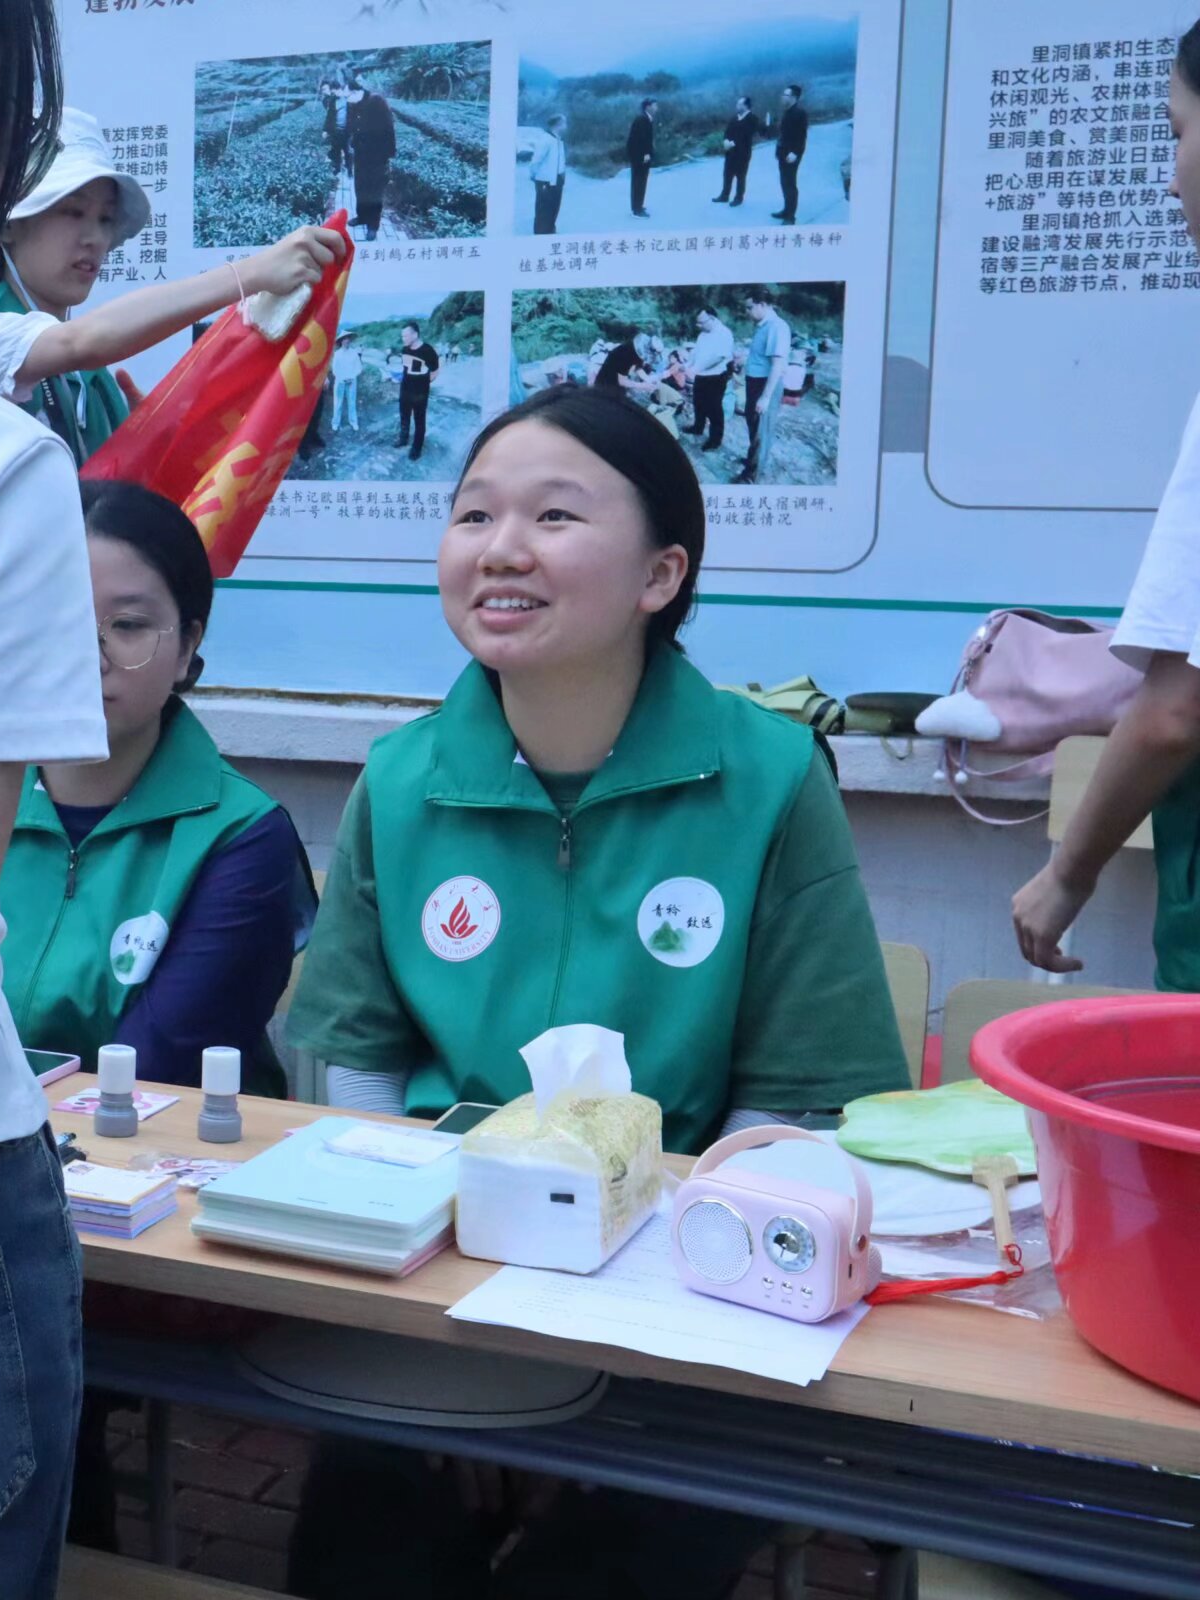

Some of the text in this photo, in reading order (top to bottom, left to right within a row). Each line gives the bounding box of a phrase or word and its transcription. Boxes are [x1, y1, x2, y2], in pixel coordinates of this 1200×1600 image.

[1032, 37, 1176, 64] 里洞镇紧扣生态
[112, 142, 168, 160] 力推动镇
[141, 179, 167, 193] 一步
[140, 230, 167, 247] 主导
[518, 257, 599, 273] 植基地调研
[708, 512, 792, 527] 的收获情况
